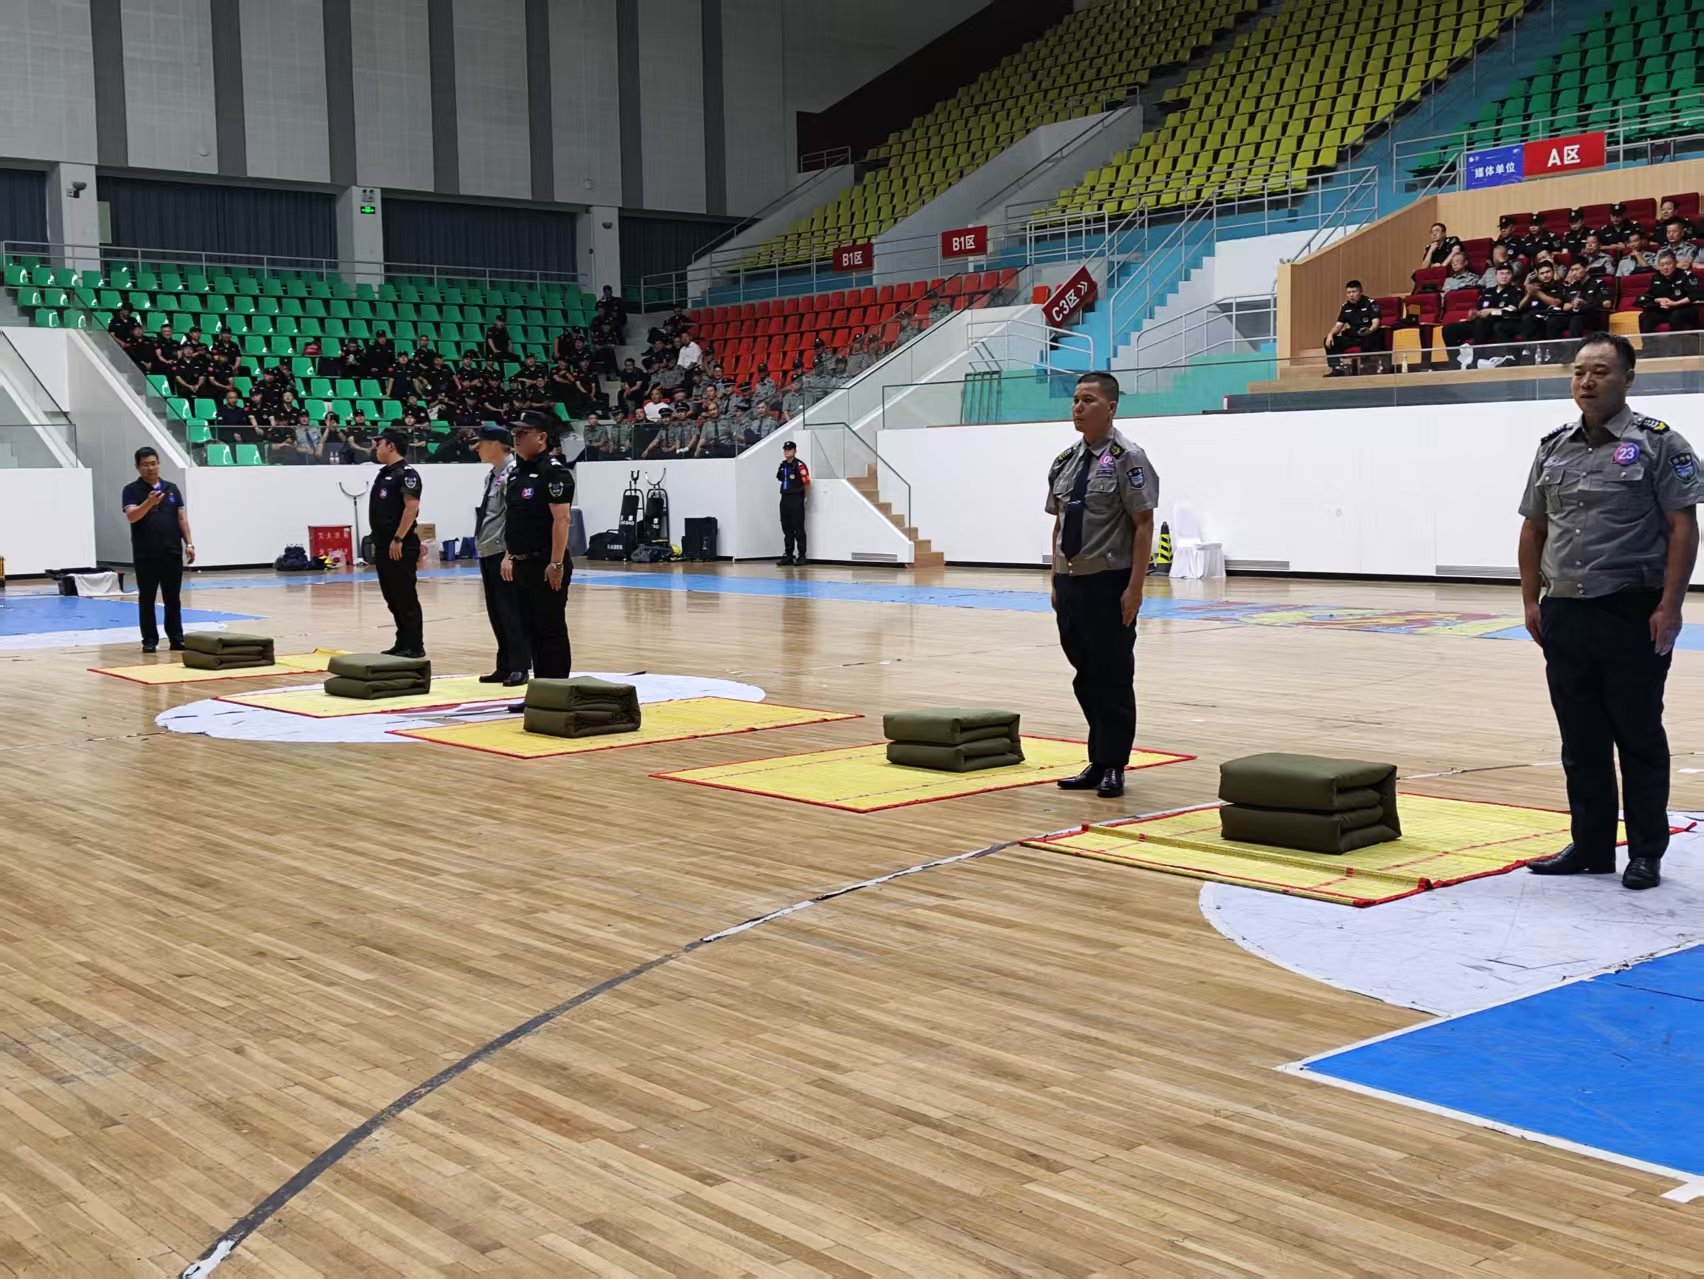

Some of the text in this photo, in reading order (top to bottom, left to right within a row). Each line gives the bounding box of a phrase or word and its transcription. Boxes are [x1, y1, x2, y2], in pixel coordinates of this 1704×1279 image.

[1547, 144, 1581, 167] A区
[1474, 162, 1516, 179] 媒体单位
[952, 235, 976, 251] B1区
[843, 251, 863, 266] B1区
[1052, 291, 1080, 321] C3区
[1618, 447, 1635, 459] 23
